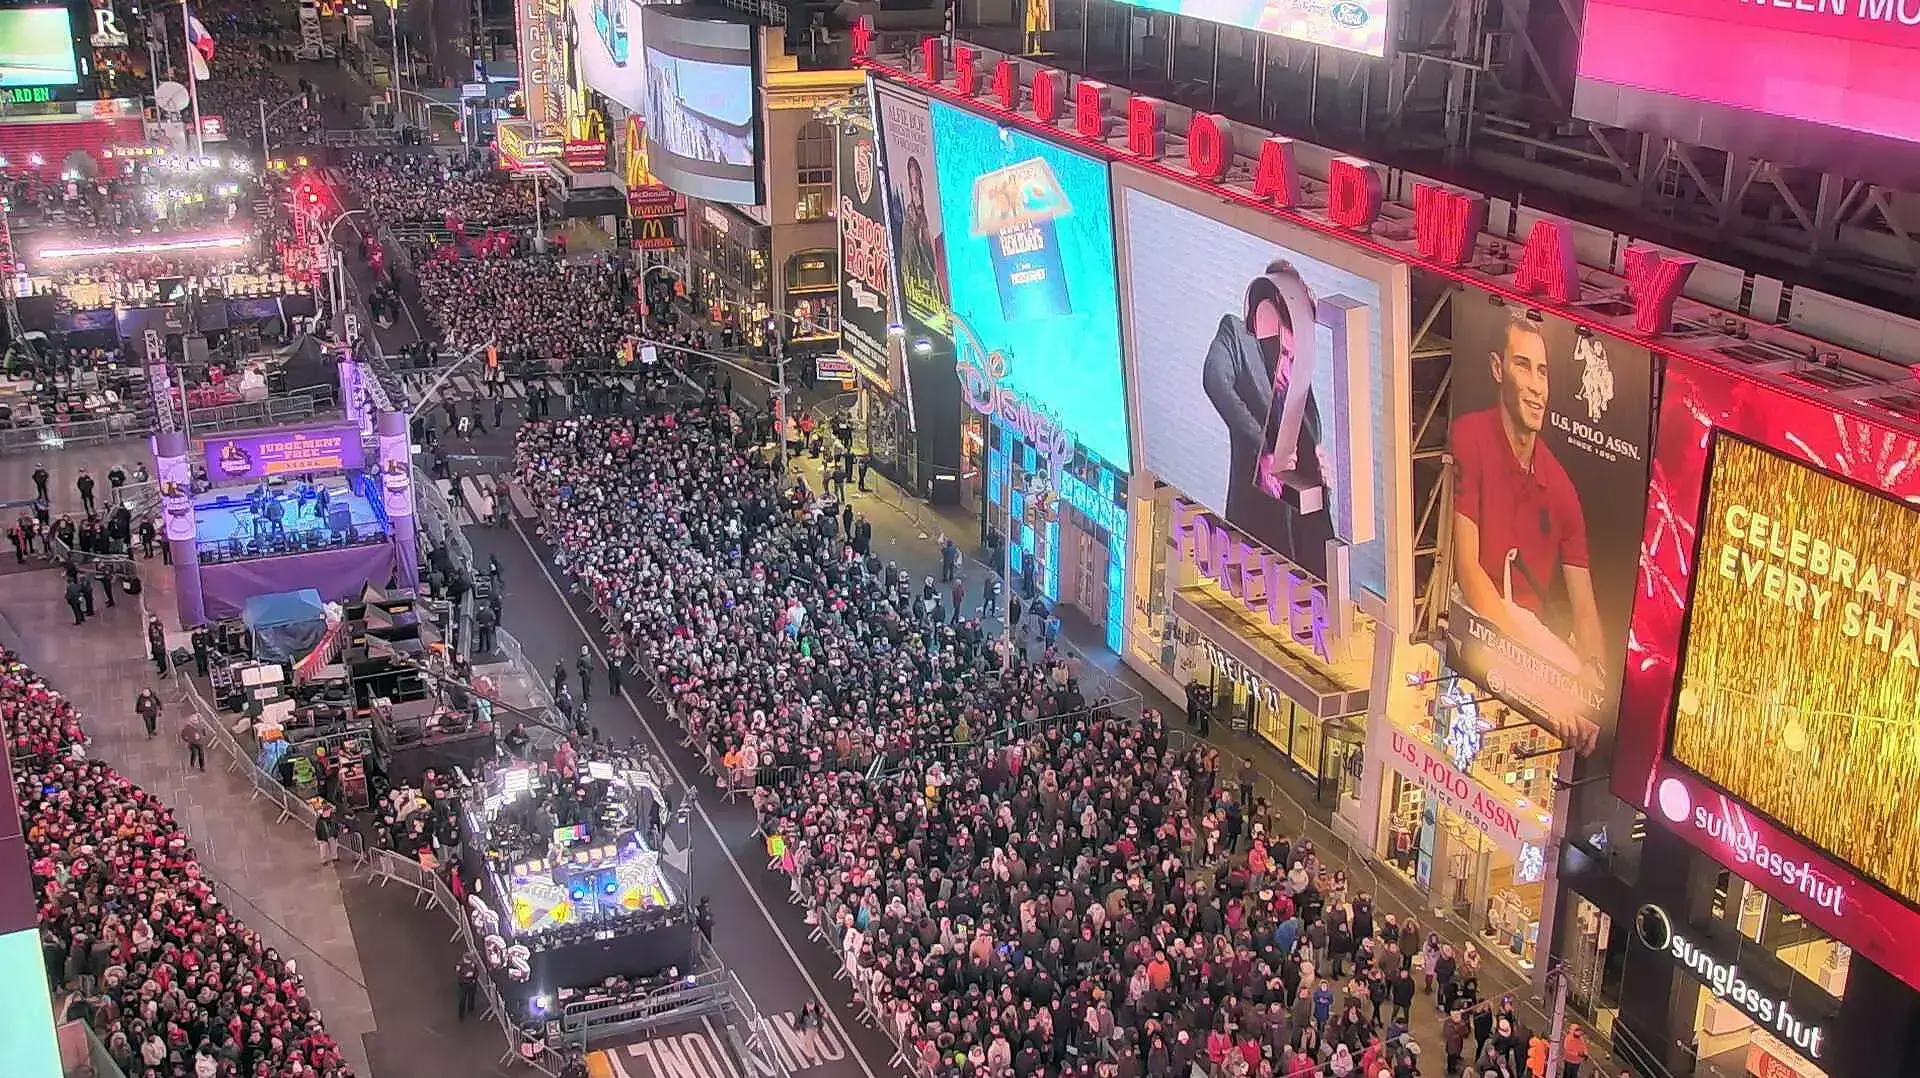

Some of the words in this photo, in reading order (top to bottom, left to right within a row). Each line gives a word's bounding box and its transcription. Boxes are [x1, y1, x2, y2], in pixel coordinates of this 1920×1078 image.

[1337, 4, 1363, 25] Ford
[630, 191, 675, 199] McDonald's
[841, 195, 887, 255] SCHOOL
[1076, 80, 1697, 334] BROADWAY
[844, 234, 887, 297] ROCK
[259, 437, 342, 455] JUDGEMENT
[284, 449, 320, 459] FREE
[1551, 413, 1571, 433] U.S.
[1572, 421, 1604, 446] POLO
[1605, 434, 1641, 461] ASSN.
[1567, 436, 1593, 453] SINCE
[1594, 447, 1617, 462] 1890
[1172, 499, 1330, 665] FOREVER
[1725, 504, 1920, 619] CELEBRATE
[1719, 543, 1832, 620] EVERY
[1842, 601, 1920, 668] SHA
[1468, 618, 1497, 648] LIVE
[1498, 641, 1605, 711] AUTHENTICALLY
[1391, 731, 1419, 767] U.S.
[1423, 752, 1469, 800] POLO
[1471, 792, 1522, 840] ASSN.
[1418, 776, 1454, 806] SINCE
[1695, 805, 1796, 885] sunglass
[1798, 862, 1845, 916] hut
[1671, 934, 1773, 1022] sunglass
[1776, 999, 1825, 1059] hut
